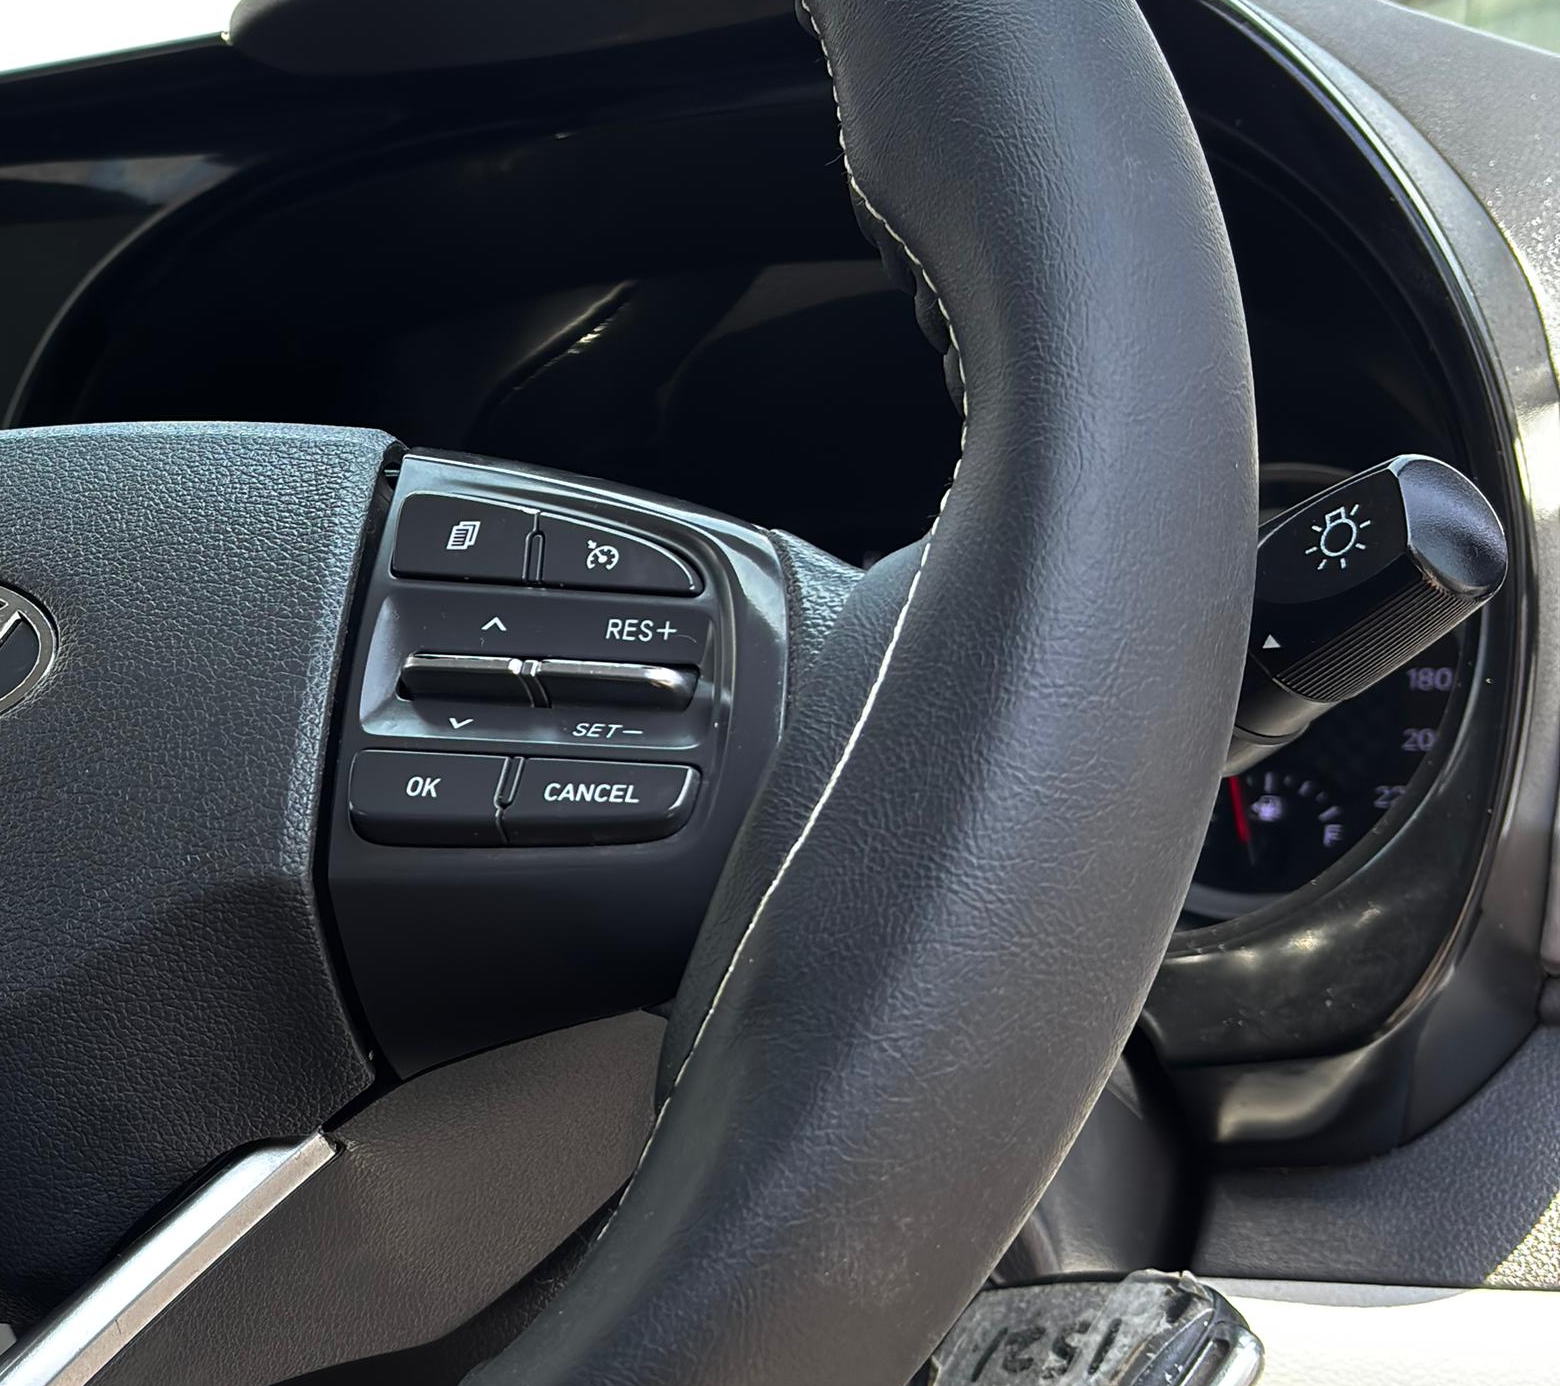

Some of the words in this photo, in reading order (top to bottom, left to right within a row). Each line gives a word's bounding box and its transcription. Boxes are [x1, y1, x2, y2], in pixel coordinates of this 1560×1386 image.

[605, 617, 678, 643] RES+
[1405, 667, 1453, 691] 180
[405, 776, 442, 799] OK
[543, 781, 640, 805] CANCEL
